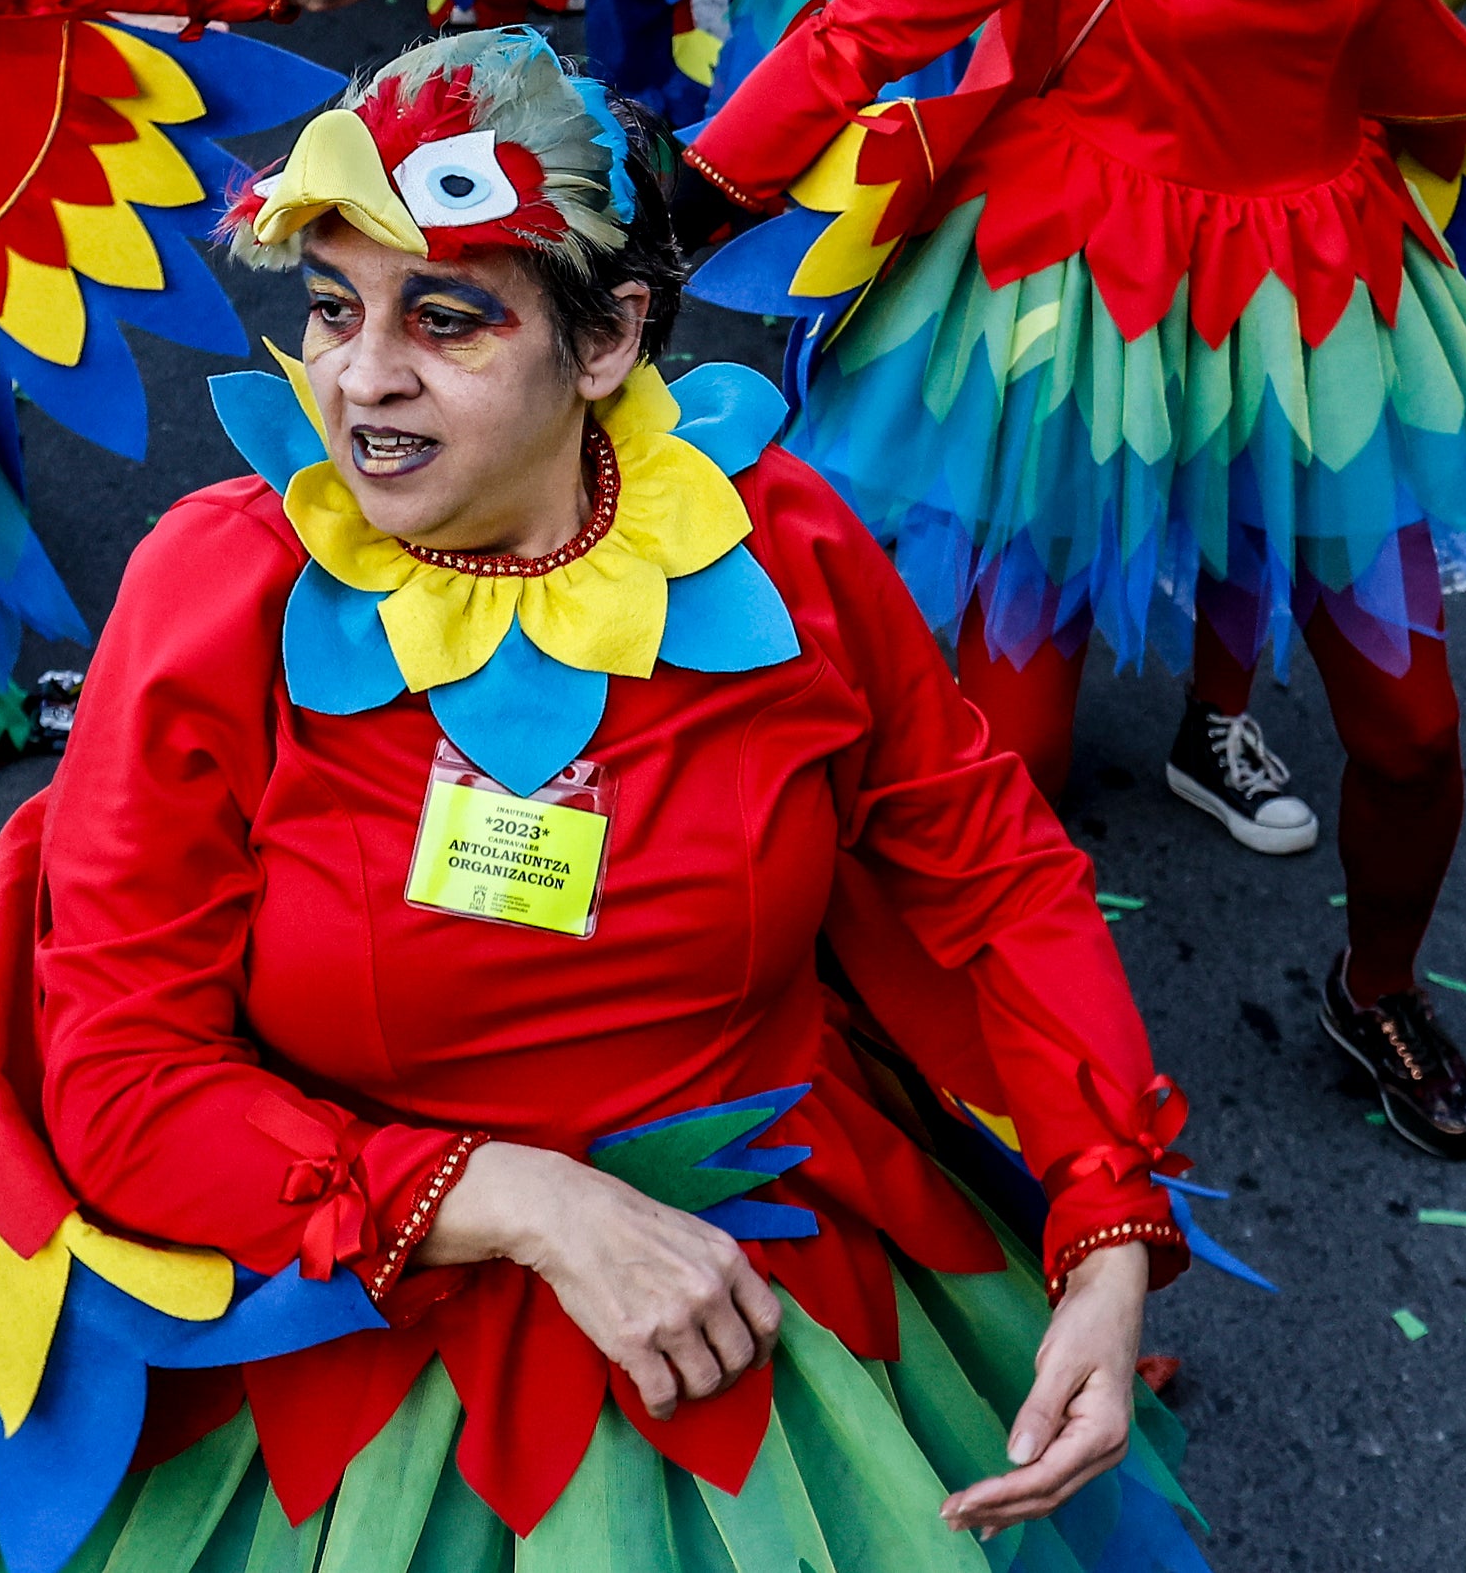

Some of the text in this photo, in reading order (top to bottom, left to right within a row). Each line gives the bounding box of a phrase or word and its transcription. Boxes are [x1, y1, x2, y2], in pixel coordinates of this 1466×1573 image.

[496, 806, 544, 822] INAUTERIAK
[488, 836, 539, 851] CARNAVALES
[449, 839, 570, 874] ANTOLAKUNTZA
[449, 856, 565, 890] ORGANIZACIÓN
